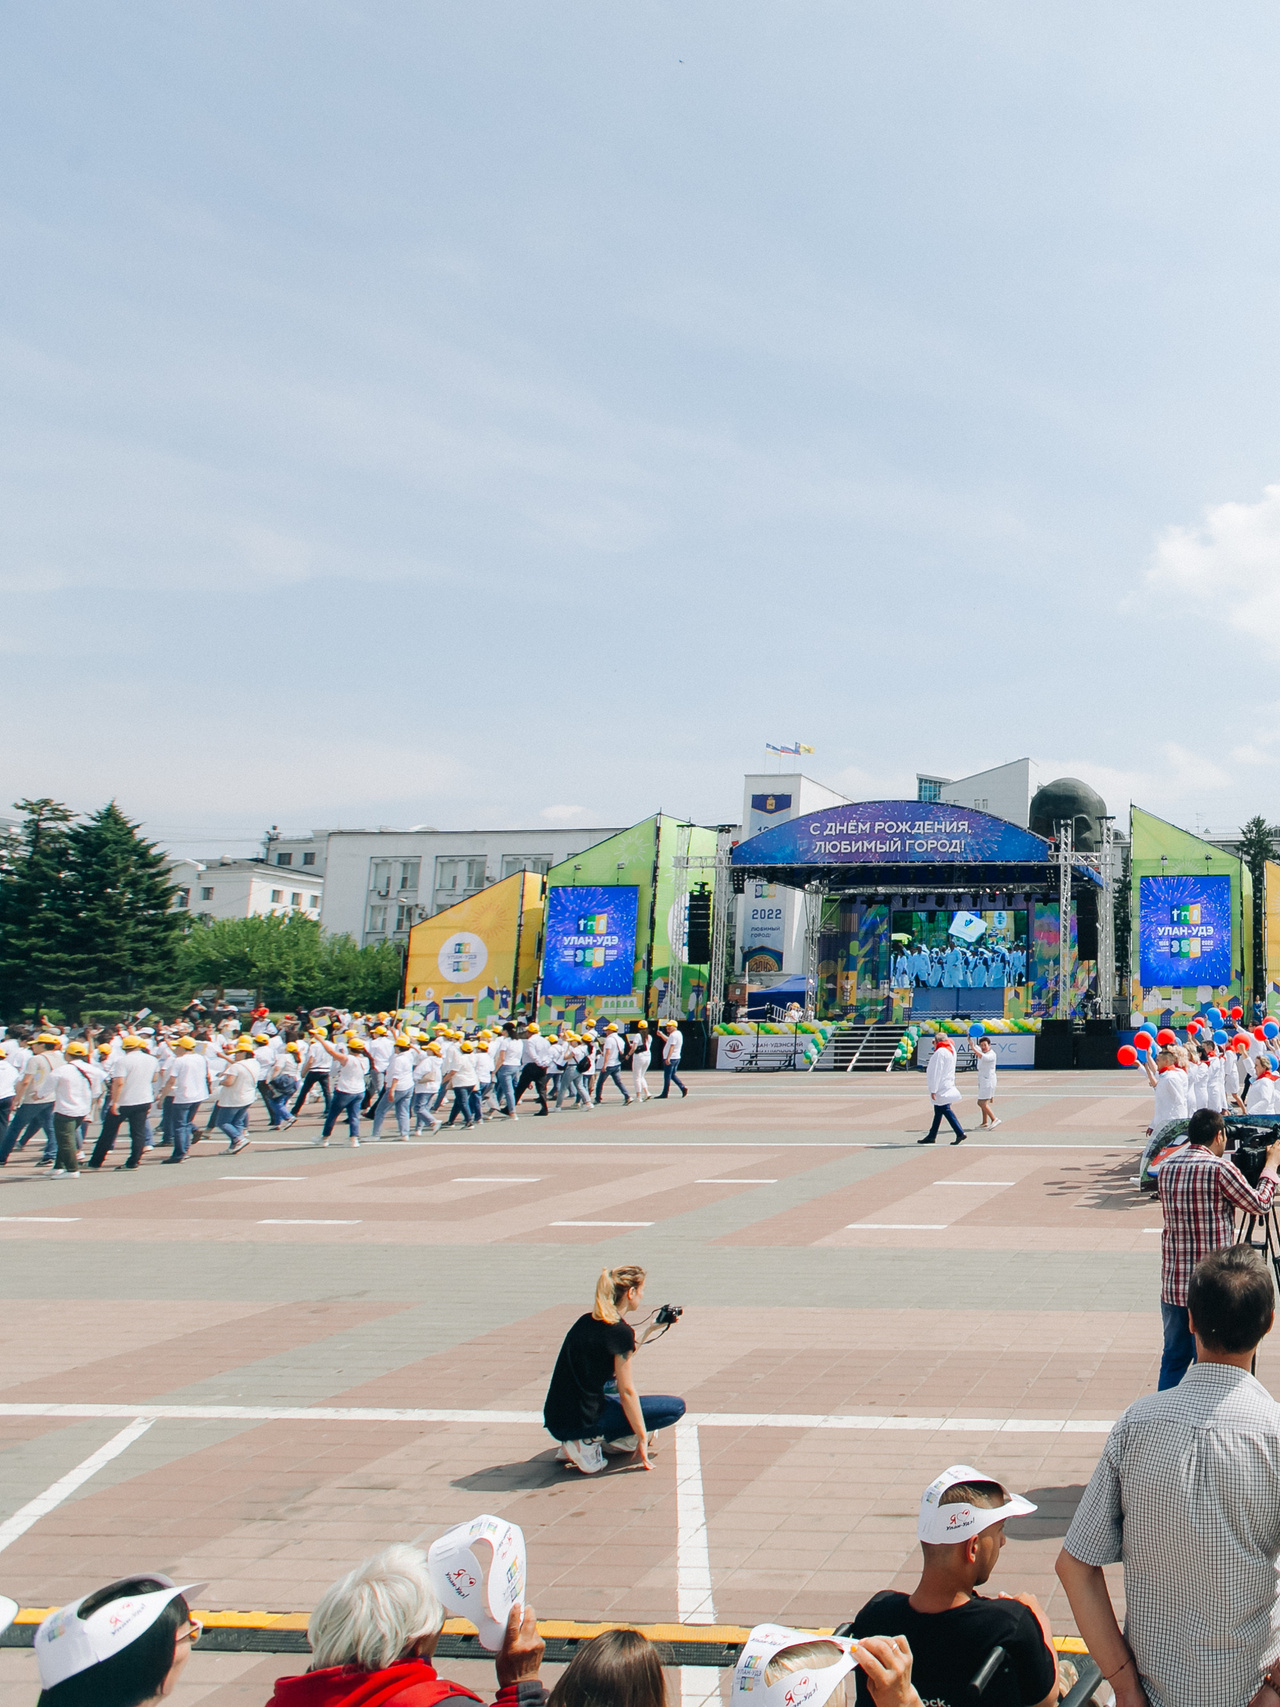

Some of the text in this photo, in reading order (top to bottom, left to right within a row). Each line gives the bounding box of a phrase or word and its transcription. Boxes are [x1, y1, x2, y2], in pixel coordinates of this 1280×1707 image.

[809, 819, 973, 836] С ДНЁМ РОЖДЕНИЯ,
[813, 837, 965, 854] ЛЮБИМЫЙ ГОРОД!
[751, 908, 782, 920] 2022
[1157, 926, 1214, 937] УЛАН-УДЭ
[563, 935, 619, 946] УЛАН-УДЭ
[949, 1513, 957, 1525] Я
[784, 1690, 795, 1706] Я
